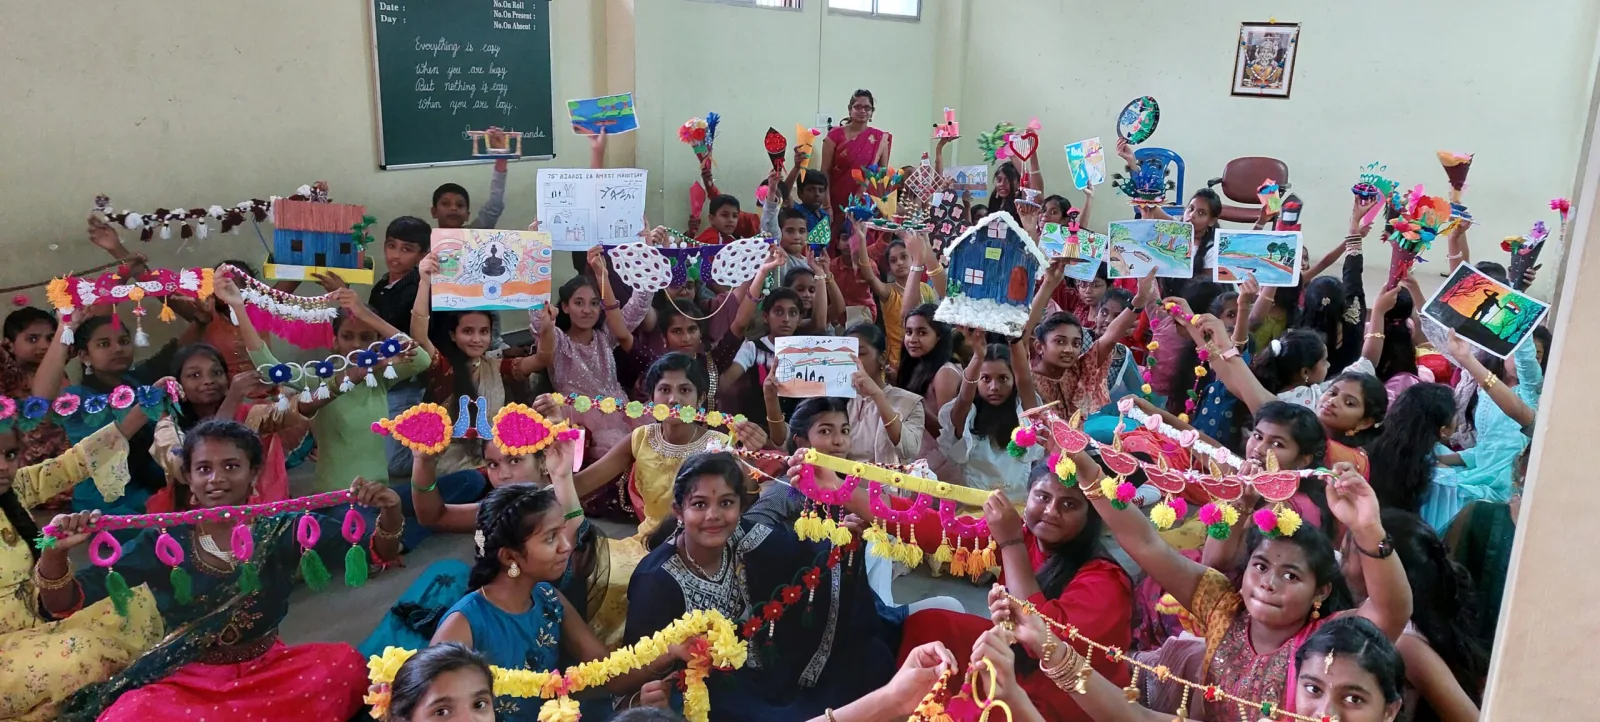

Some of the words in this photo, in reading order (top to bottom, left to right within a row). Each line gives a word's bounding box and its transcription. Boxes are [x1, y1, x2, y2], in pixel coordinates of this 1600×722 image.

[379, 1, 399, 11] Date
[493, 0, 511, 9] No.On
[512, 0, 525, 9] Roll
[380, 14, 397, 25] Day
[493, 9, 512, 19] No.On
[511, 10, 532, 20] Present
[493, 20, 512, 30] No.On
[512, 21, 531, 30] Absent
[415, 36, 460, 58] Everything
[465, 41, 474, 52] is
[480, 43, 501, 58] easy
[415, 61, 439, 75] When
[447, 66, 462, 80] you
[467, 66, 485, 75] are
[488, 62, 507, 80] busy
[415, 77, 435, 92] But
[445, 79, 476, 98] nothing
[481, 80, 489, 94] is
[489, 82, 508, 97] easy
[417, 95, 442, 110] When
[450, 100, 467, 115] you
[472, 100, 489, 109] are
[494, 96, 517, 116] lazy.
